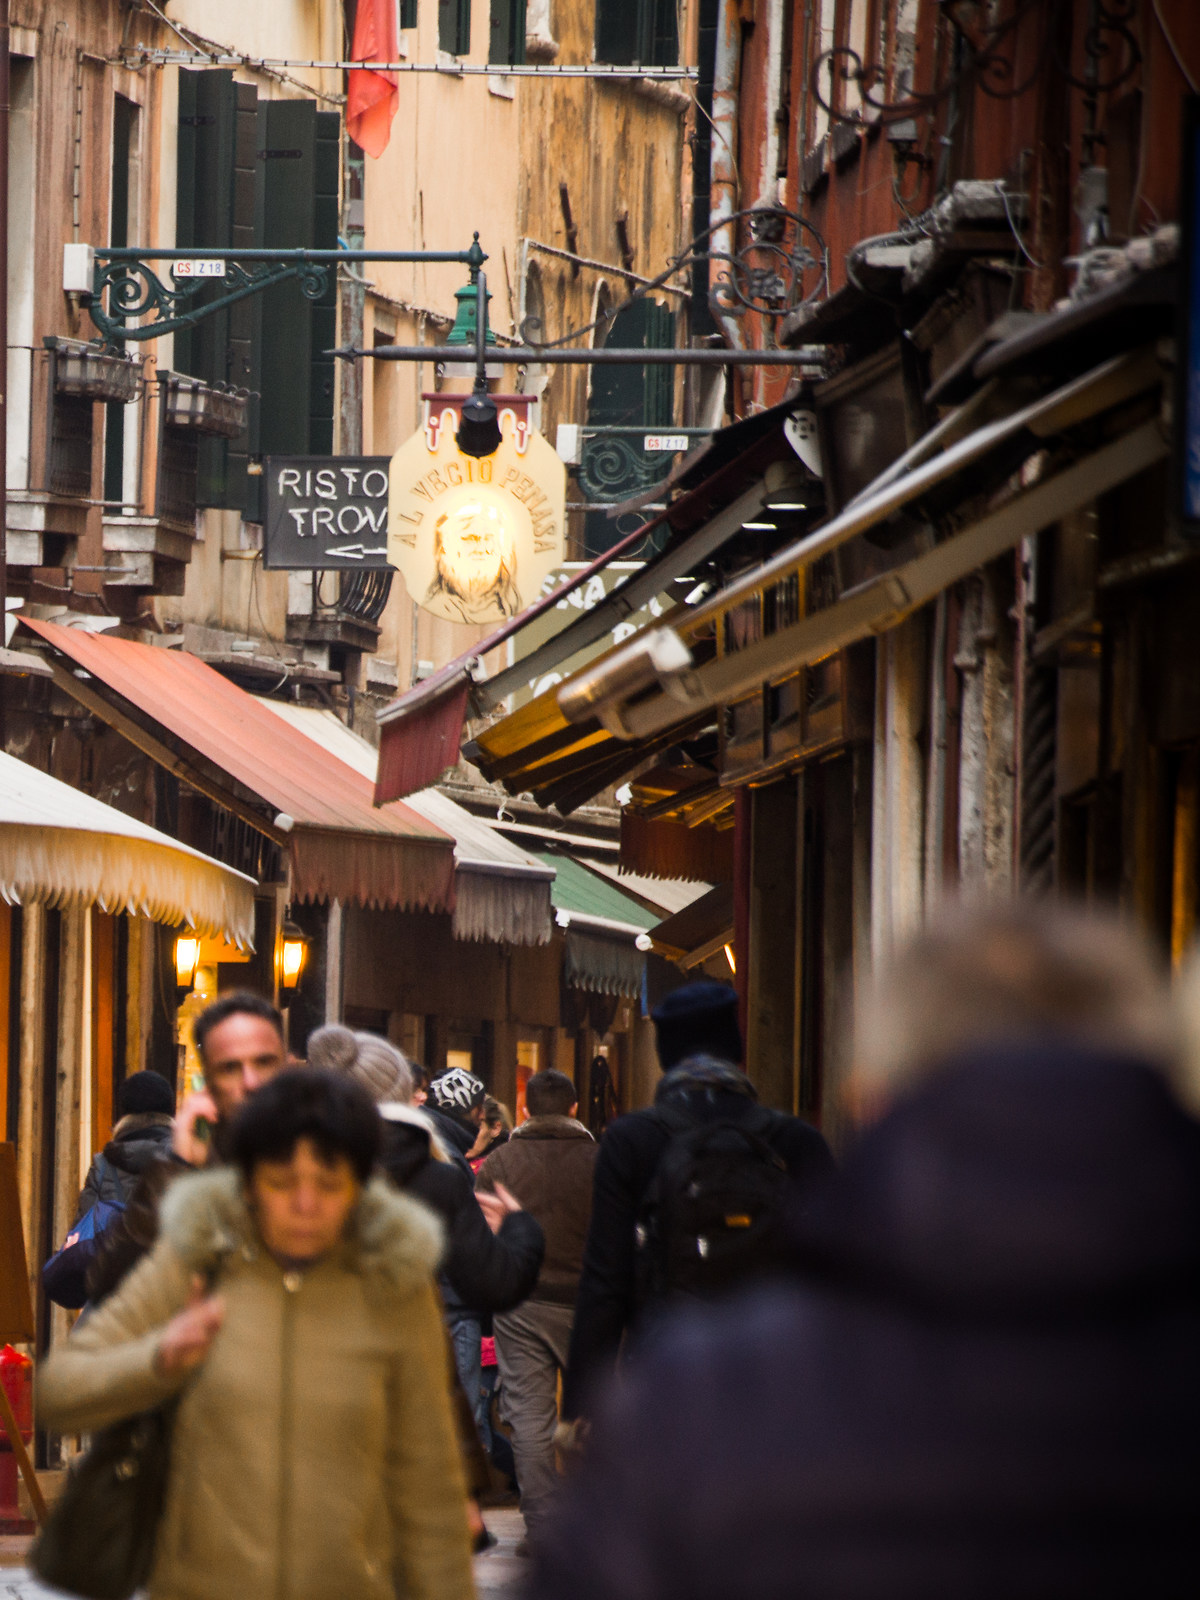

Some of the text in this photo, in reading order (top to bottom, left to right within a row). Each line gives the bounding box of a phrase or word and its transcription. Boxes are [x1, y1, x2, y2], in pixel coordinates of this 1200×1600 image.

[177, 262, 221, 273] CS Z 18
[648, 438, 660, 448] CS
[675, 439, 685, 448] 17
[391, 459, 557, 555] AL VECIO PENASA
[288, 505, 389, 538] TROV
